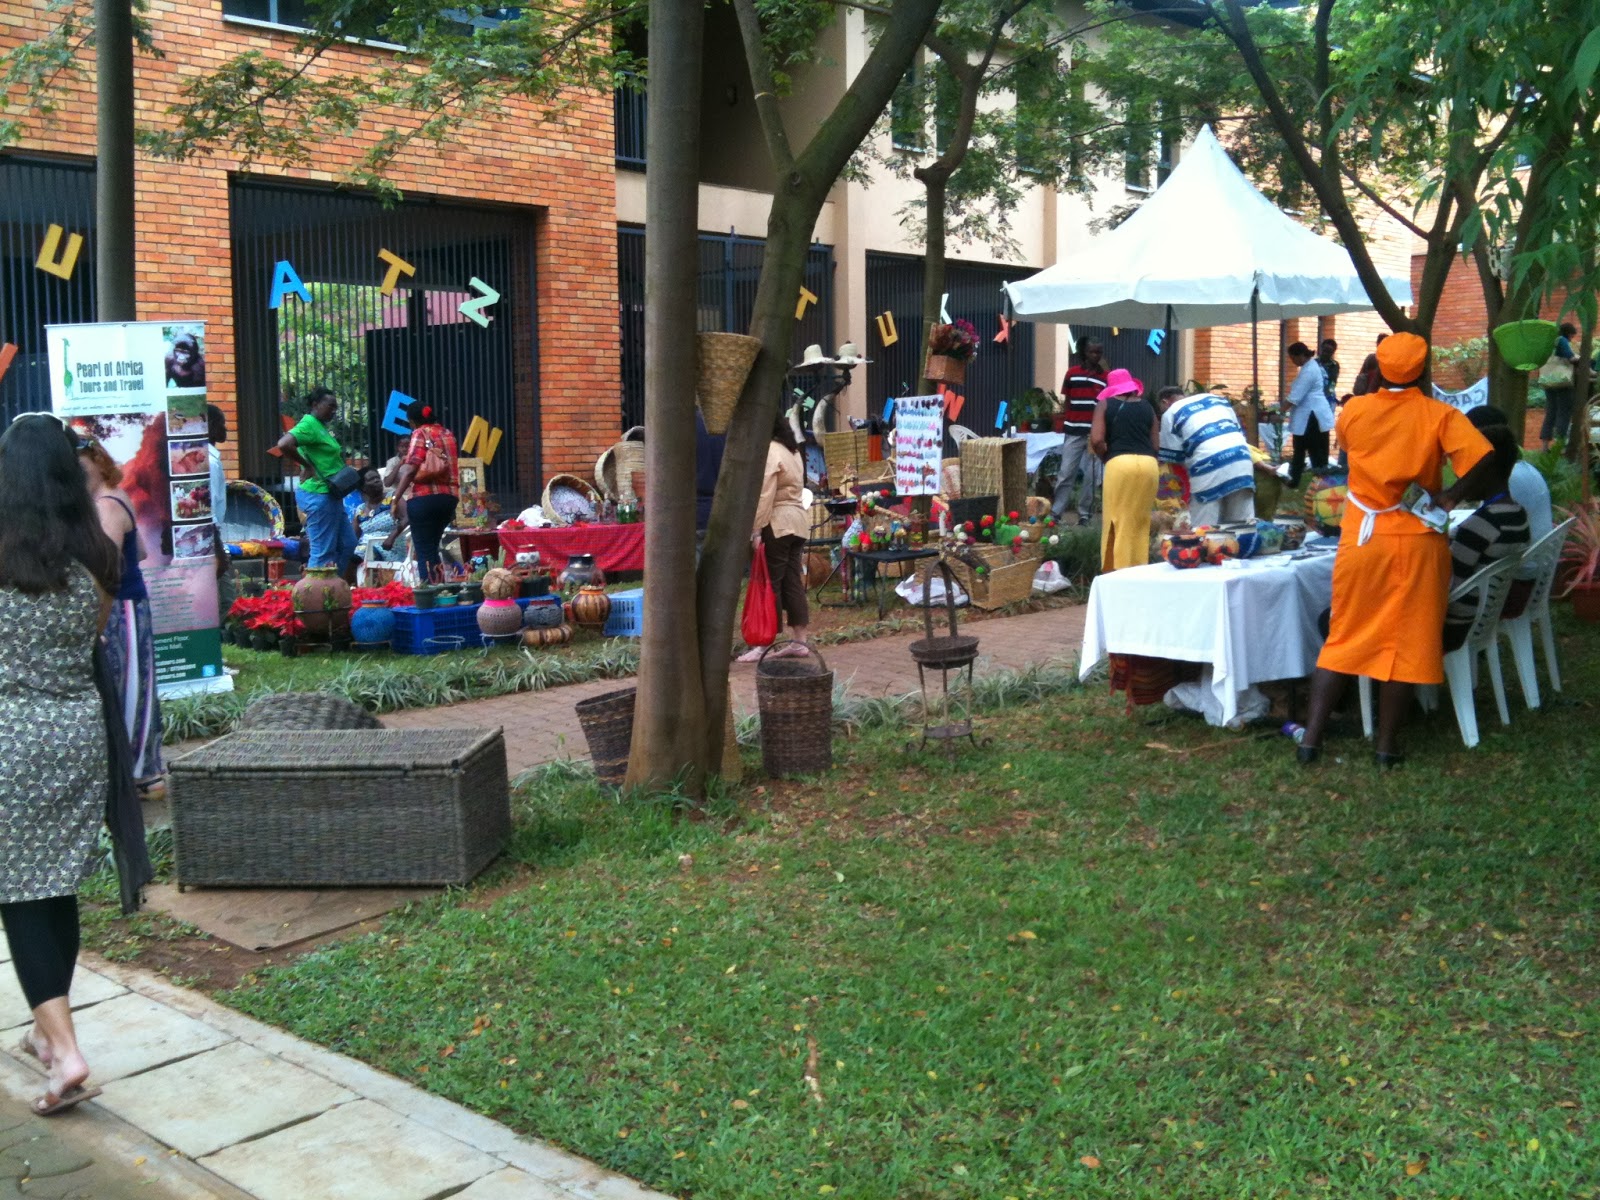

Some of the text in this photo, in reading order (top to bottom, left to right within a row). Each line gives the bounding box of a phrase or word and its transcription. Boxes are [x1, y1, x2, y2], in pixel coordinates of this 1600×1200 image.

[35, 223, 83, 281] U
[378, 248, 416, 297] T
[269, 261, 312, 309] A
[875, 310, 899, 347] U
[77, 361, 143, 378] Pearl of Africa
[80, 378, 144, 393] Tours and Travel
[381, 390, 418, 435] E
[461, 415, 502, 465] N
